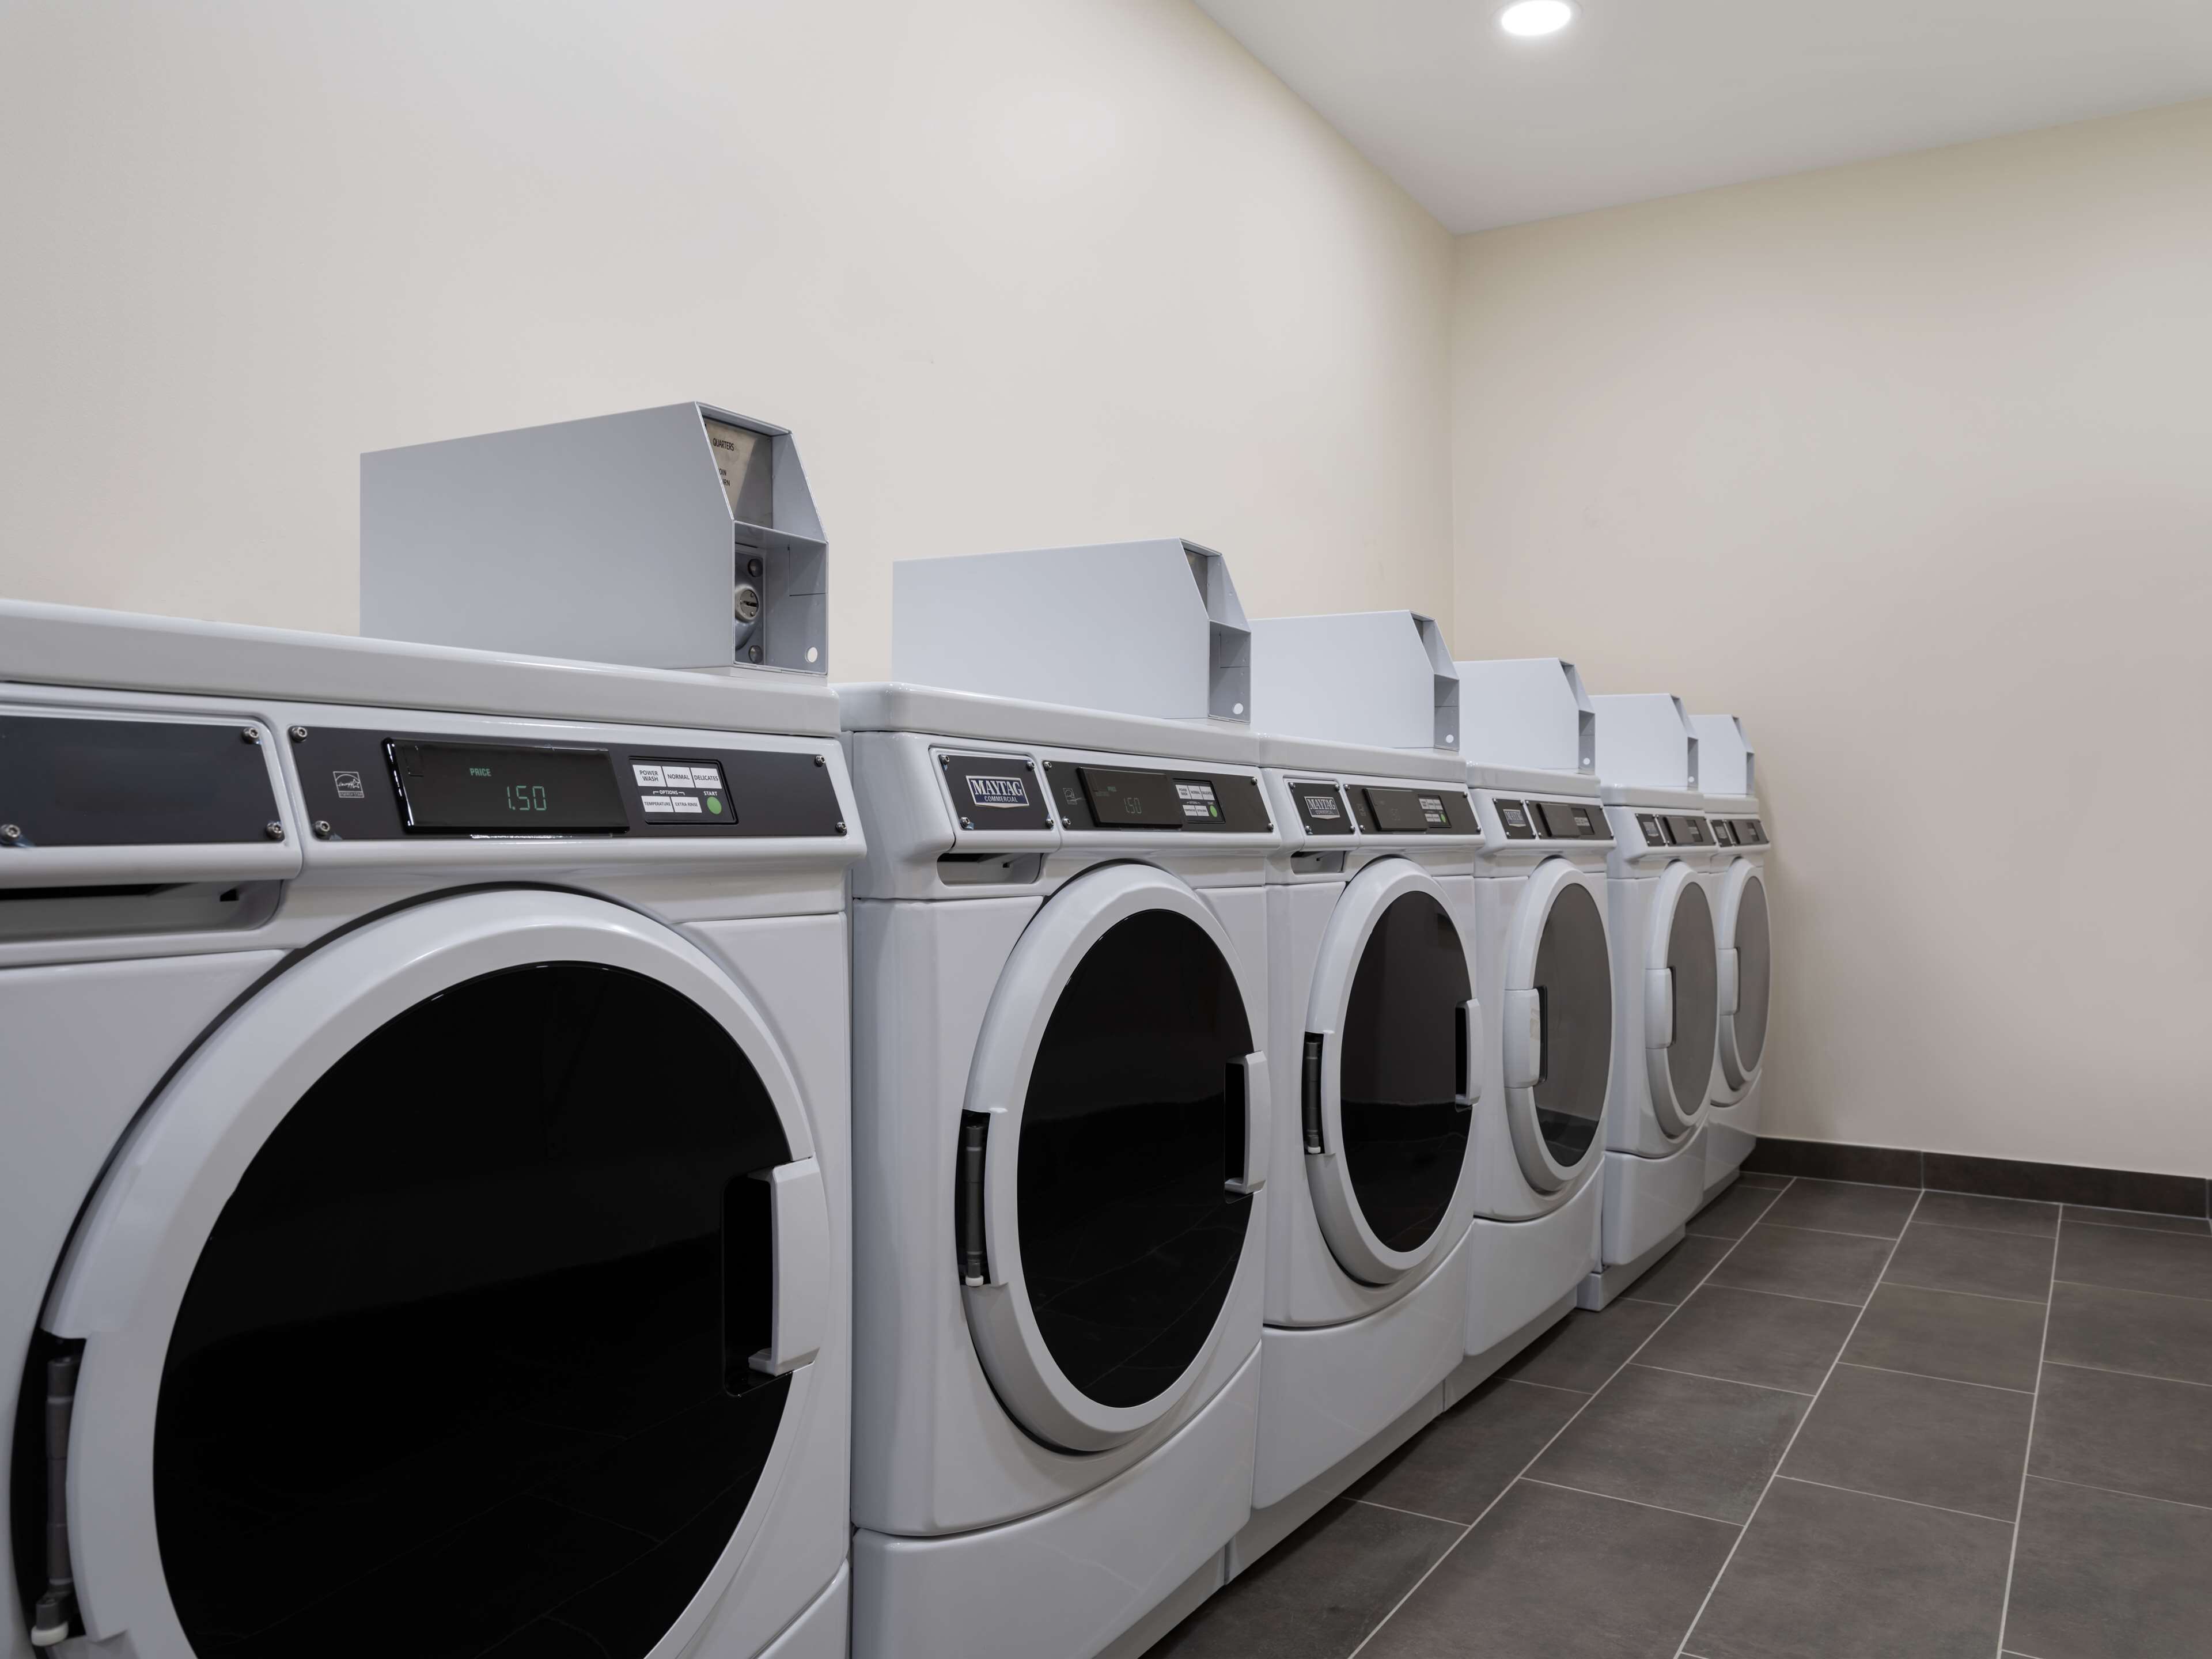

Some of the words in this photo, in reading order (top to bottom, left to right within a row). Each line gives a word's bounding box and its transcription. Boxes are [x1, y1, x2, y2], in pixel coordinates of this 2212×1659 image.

[713, 438, 734, 451] QUARTERS
[469, 768, 491, 777] PRICE
[971, 779, 1023, 796] MAYTAG
[507, 785, 547, 810] 1.50
[1306, 798, 1336, 810] MAYTAG
